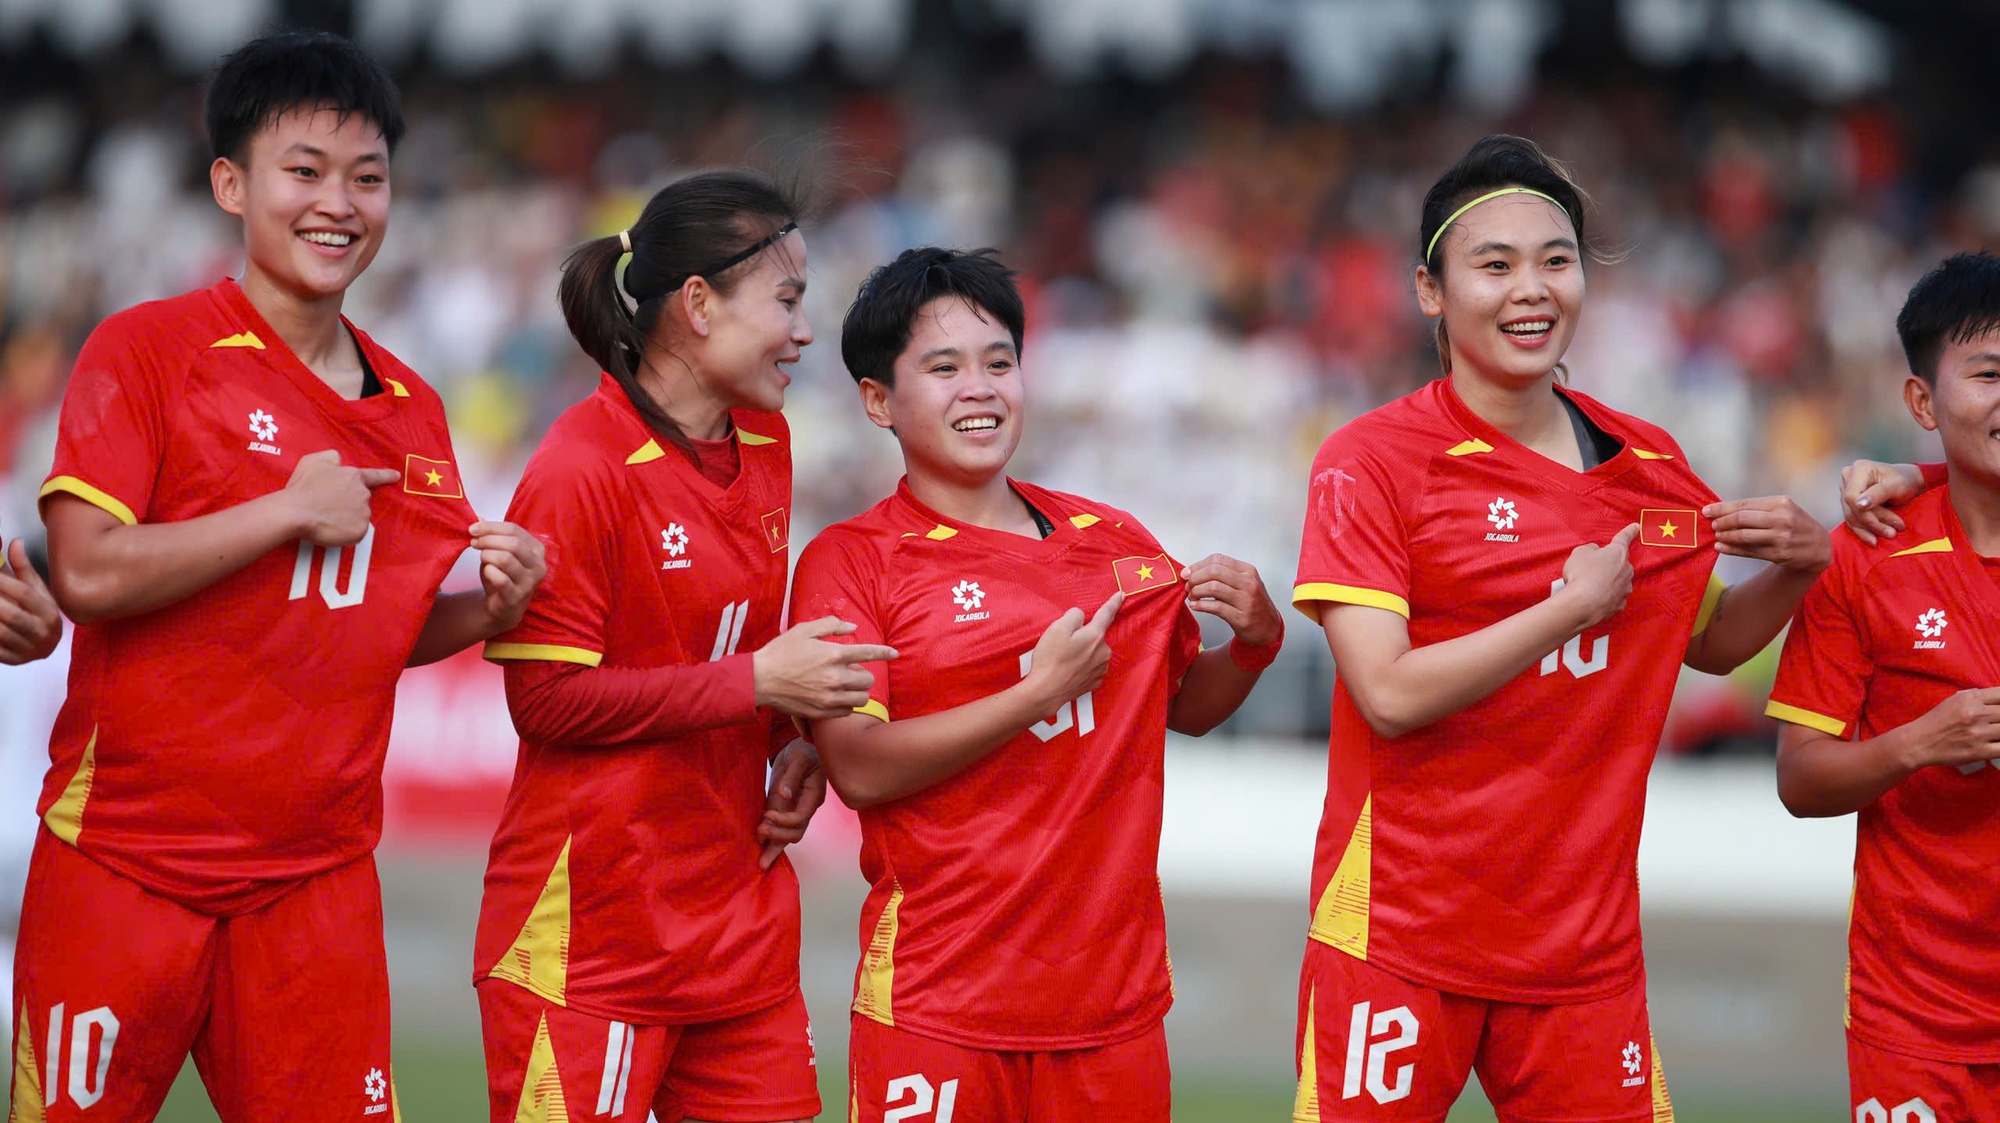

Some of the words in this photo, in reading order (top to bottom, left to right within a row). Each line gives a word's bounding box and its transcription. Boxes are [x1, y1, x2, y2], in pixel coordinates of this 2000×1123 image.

[1484, 532, 1519, 543] JOGARBOLA
[953, 611, 990, 623] JOGARBOLA
[45, 1002, 120, 1110] 10
[595, 1021, 635, 1118] 11
[1342, 1000, 1420, 1105] 12
